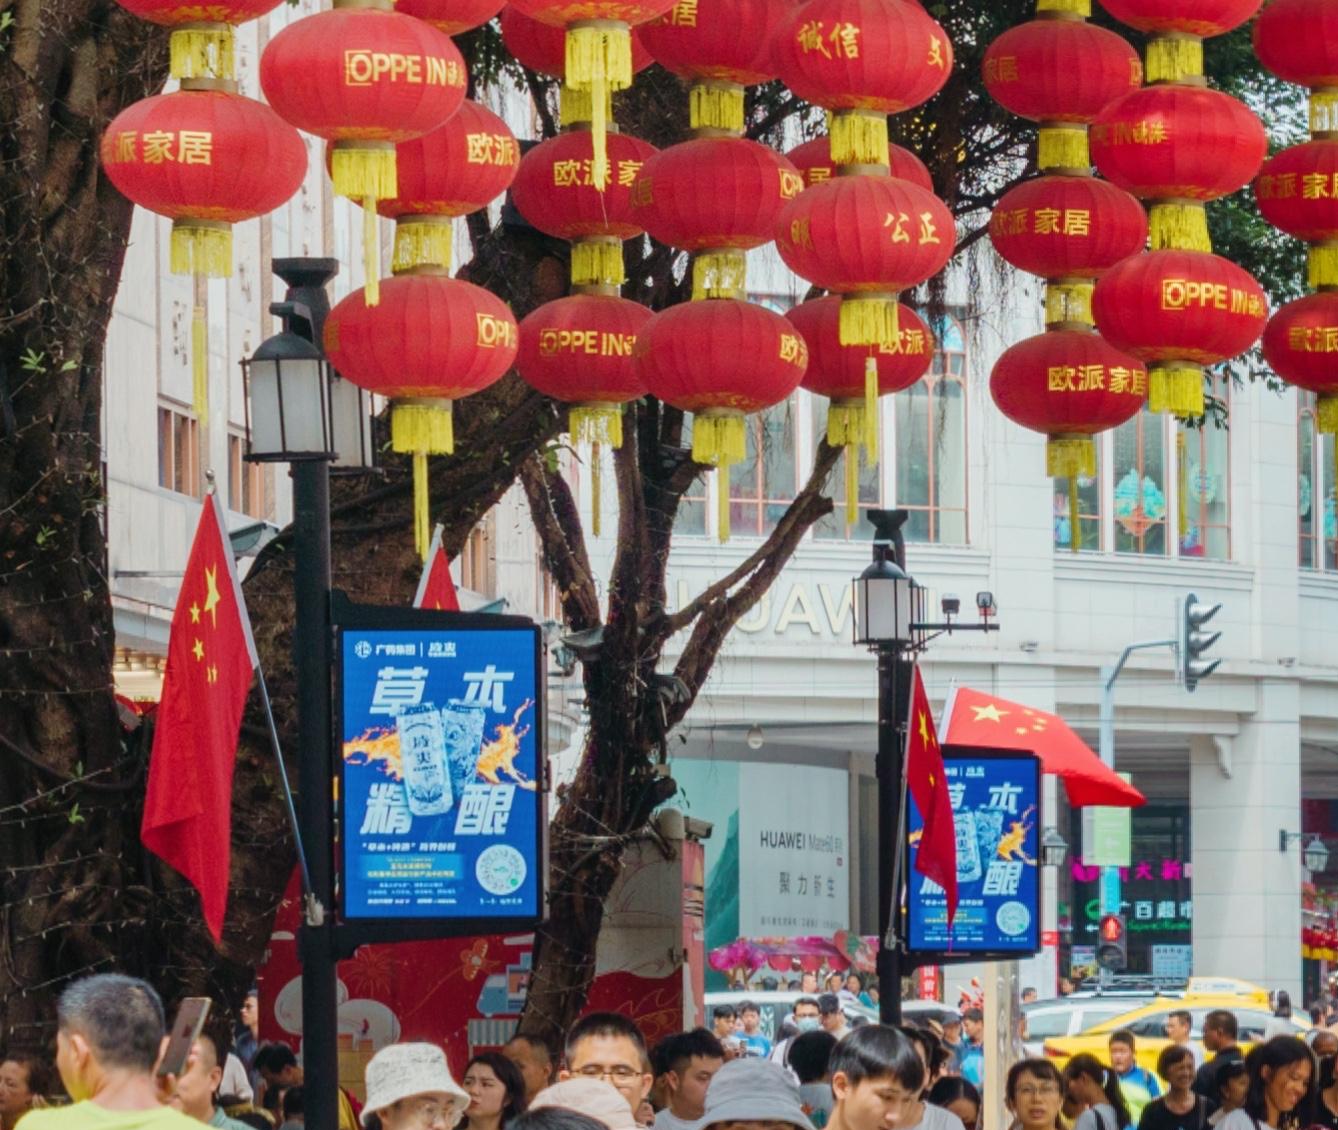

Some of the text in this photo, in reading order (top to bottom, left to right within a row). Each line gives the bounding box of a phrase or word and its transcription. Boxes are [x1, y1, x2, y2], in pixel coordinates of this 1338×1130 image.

[797, 20, 860, 59] 诚信
[884, 212, 940, 245] 公正
[760, 831, 806, 850] HUAWEI
